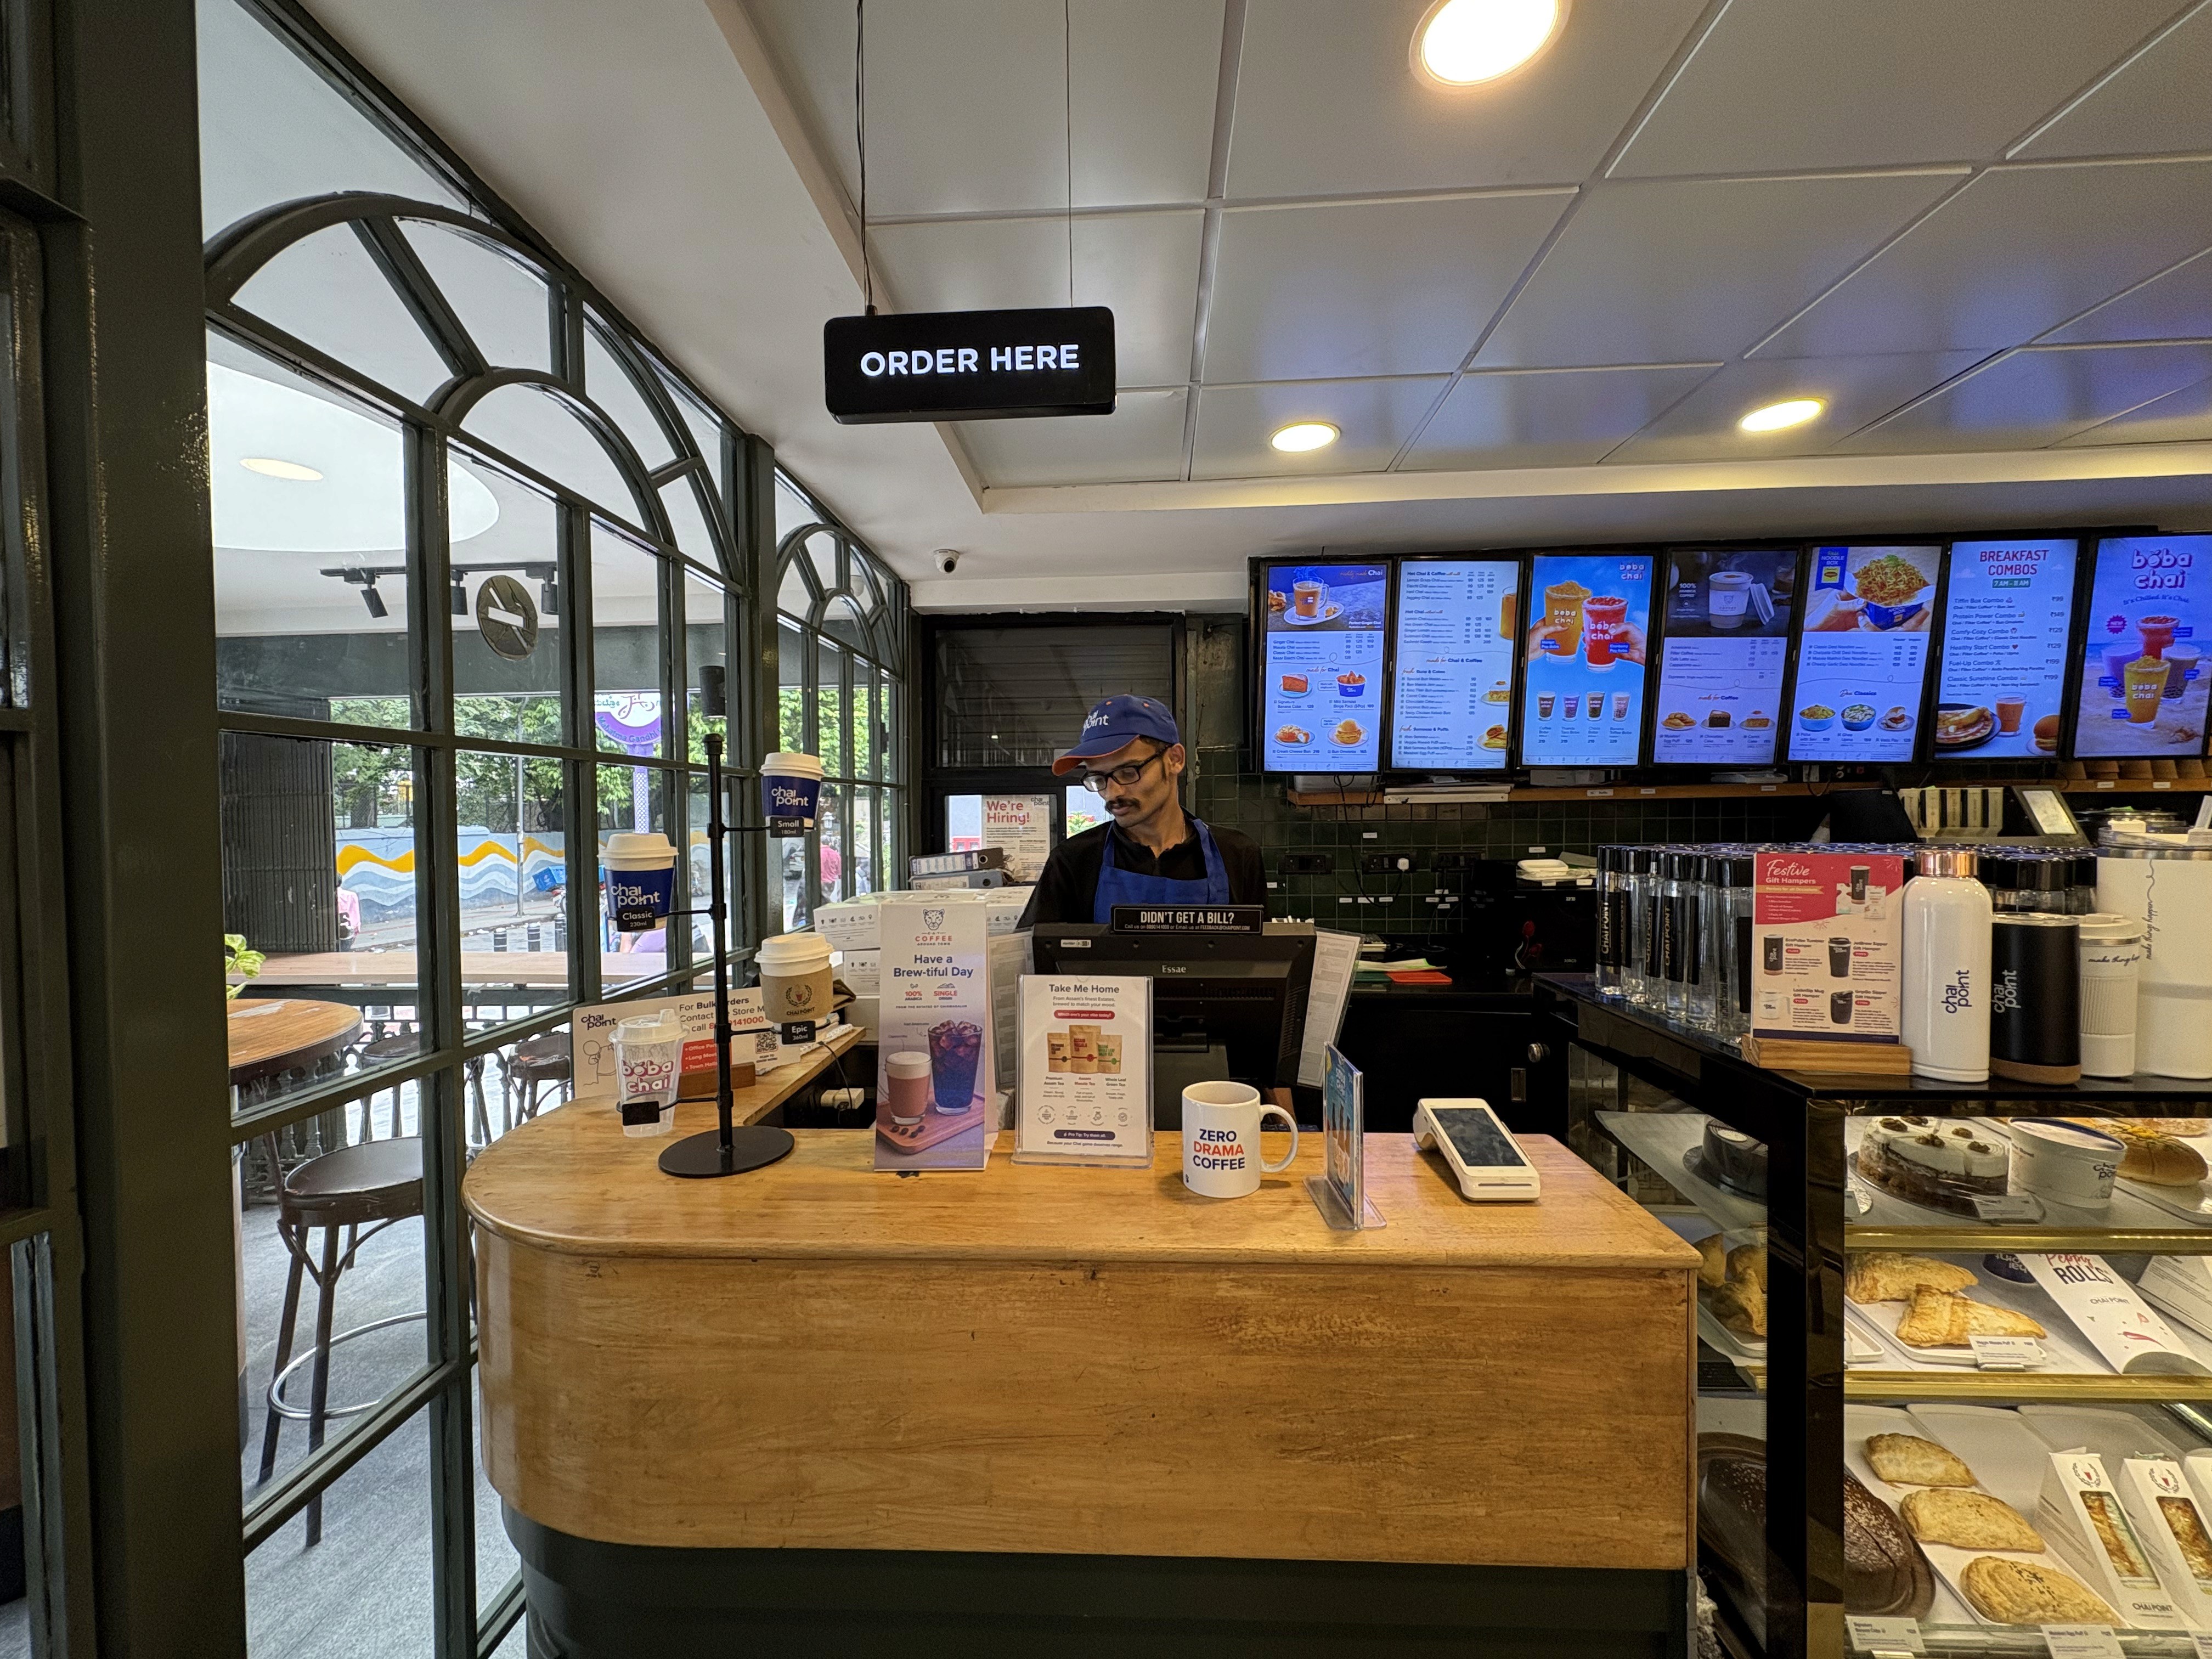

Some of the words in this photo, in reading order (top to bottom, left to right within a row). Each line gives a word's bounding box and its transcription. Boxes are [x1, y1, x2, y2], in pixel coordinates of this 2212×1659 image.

[860, 348, 978, 376] ORDER
[991, 344, 1080, 371] HERE
[1980, 550, 2049, 562] BREAKFAST
[1621, 572, 1643, 580] chai
[1988, 564, 2038, 575] COMBOS
[2135, 569, 2185, 589] chai
[597, 716, 627, 741] Mahatma
[629, 730, 658, 742] Gandhi
[771, 786, 796, 797] chai
[776, 797, 809, 806] point
[987, 800, 1024, 811] We're
[987, 812, 1030, 825] Hiring!
[1767, 859, 1810, 877] Festive
[611, 883, 642, 896] chai
[618, 891, 661, 909] point
[623, 911, 653, 920] Classic
[1141, 911, 1173, 923] DIDN'T
[1176, 911, 1195, 923] GET
[1197, 912, 1204, 923] A
[1207, 912, 1234, 924] BILL?
[2141, 900, 2158, 923] happen
[2141, 944, 2152, 960] make
[915, 955, 943, 963] Have
[894, 967, 948, 977] Brew-tiful
[951, 967, 974, 978] Day
[1161, 965, 1186, 973] Essae
[1049, 984, 1071, 992] Take
[1091, 985, 1120, 993] Home
[1956, 969, 1972, 1007] point
[2002, 969, 2022, 1008] point
[1941, 985, 1957, 1014] chai
[1991, 984, 2005, 1013] chai
[581, 1014, 604, 1023] chai
[680, 1012, 714, 1022] Contact
[587, 1018, 617, 1030] point
[691, 1024, 706, 1032] call
[792, 1025, 808, 1034] Epic
[626, 1074, 670, 1093] chai
[1199, 1128, 1237, 1142] ZERO
[1194, 1141, 1244, 1156] DRAMA
[1193, 1155, 1245, 1170] COFFEE
[2053, 1265, 2114, 1284] ROLLS
[2090, 1296, 2108, 1305] CHAI
